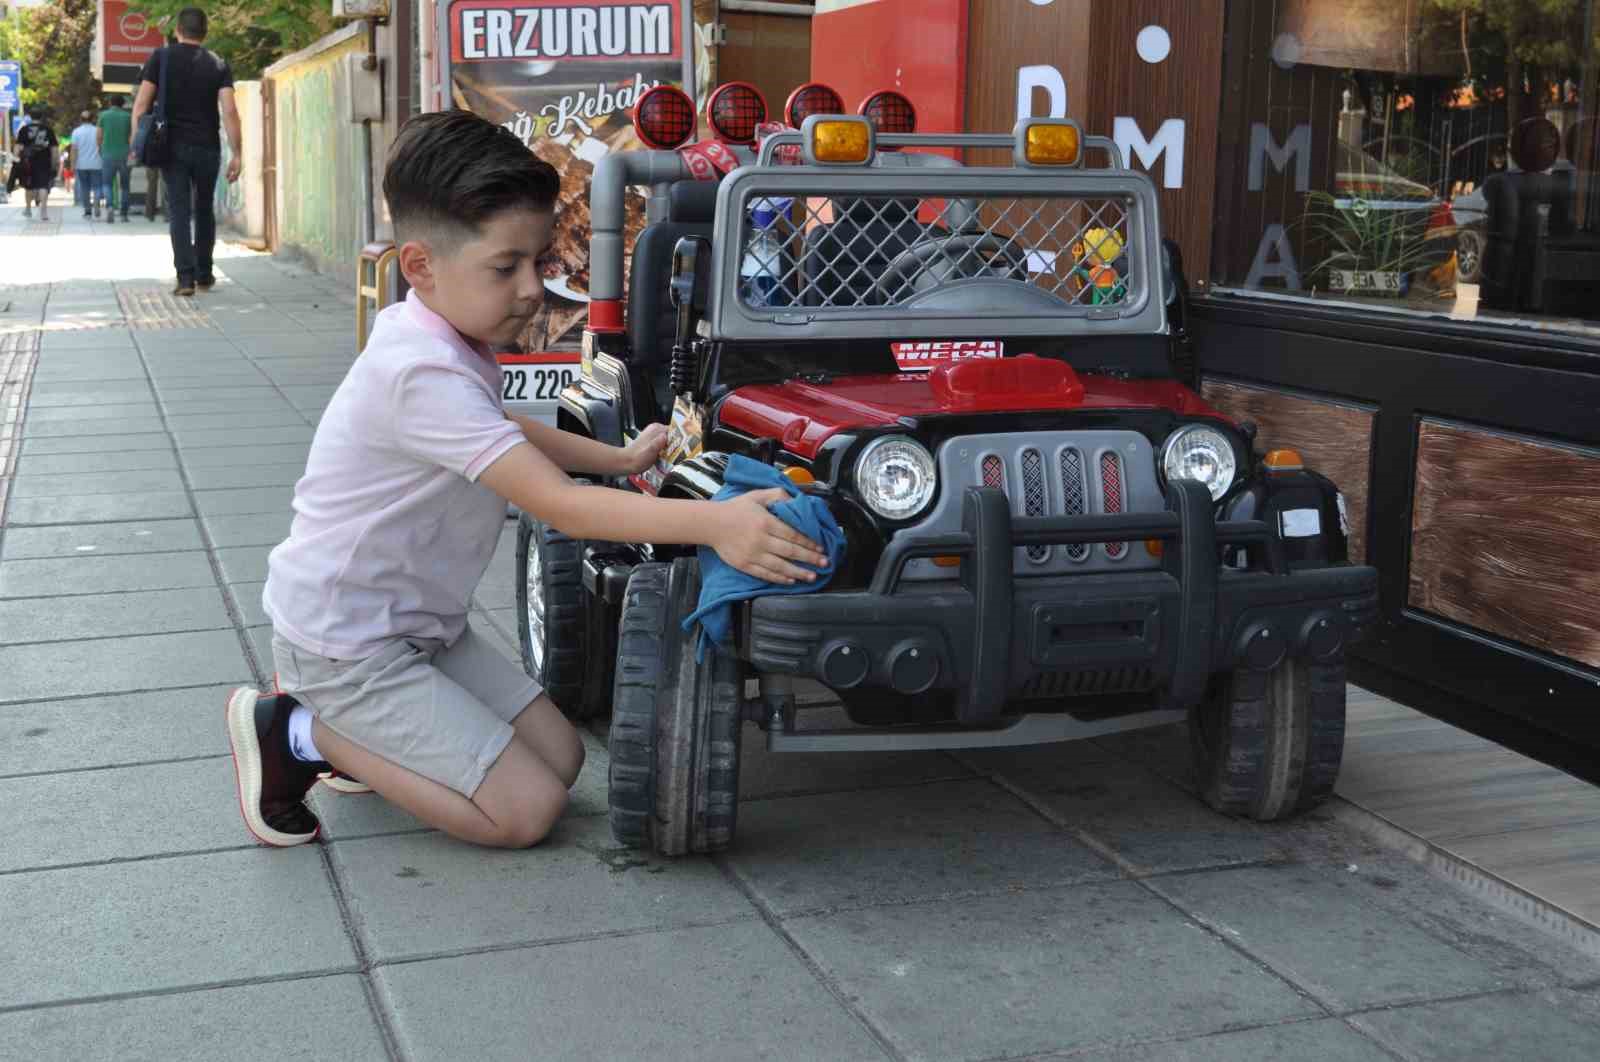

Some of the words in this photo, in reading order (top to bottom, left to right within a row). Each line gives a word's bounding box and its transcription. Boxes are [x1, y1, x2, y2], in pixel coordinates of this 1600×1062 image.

[462, 5, 671, 58] ERZURUM
[1112, 115, 1186, 189] M
[896, 341, 997, 361] MEGA
